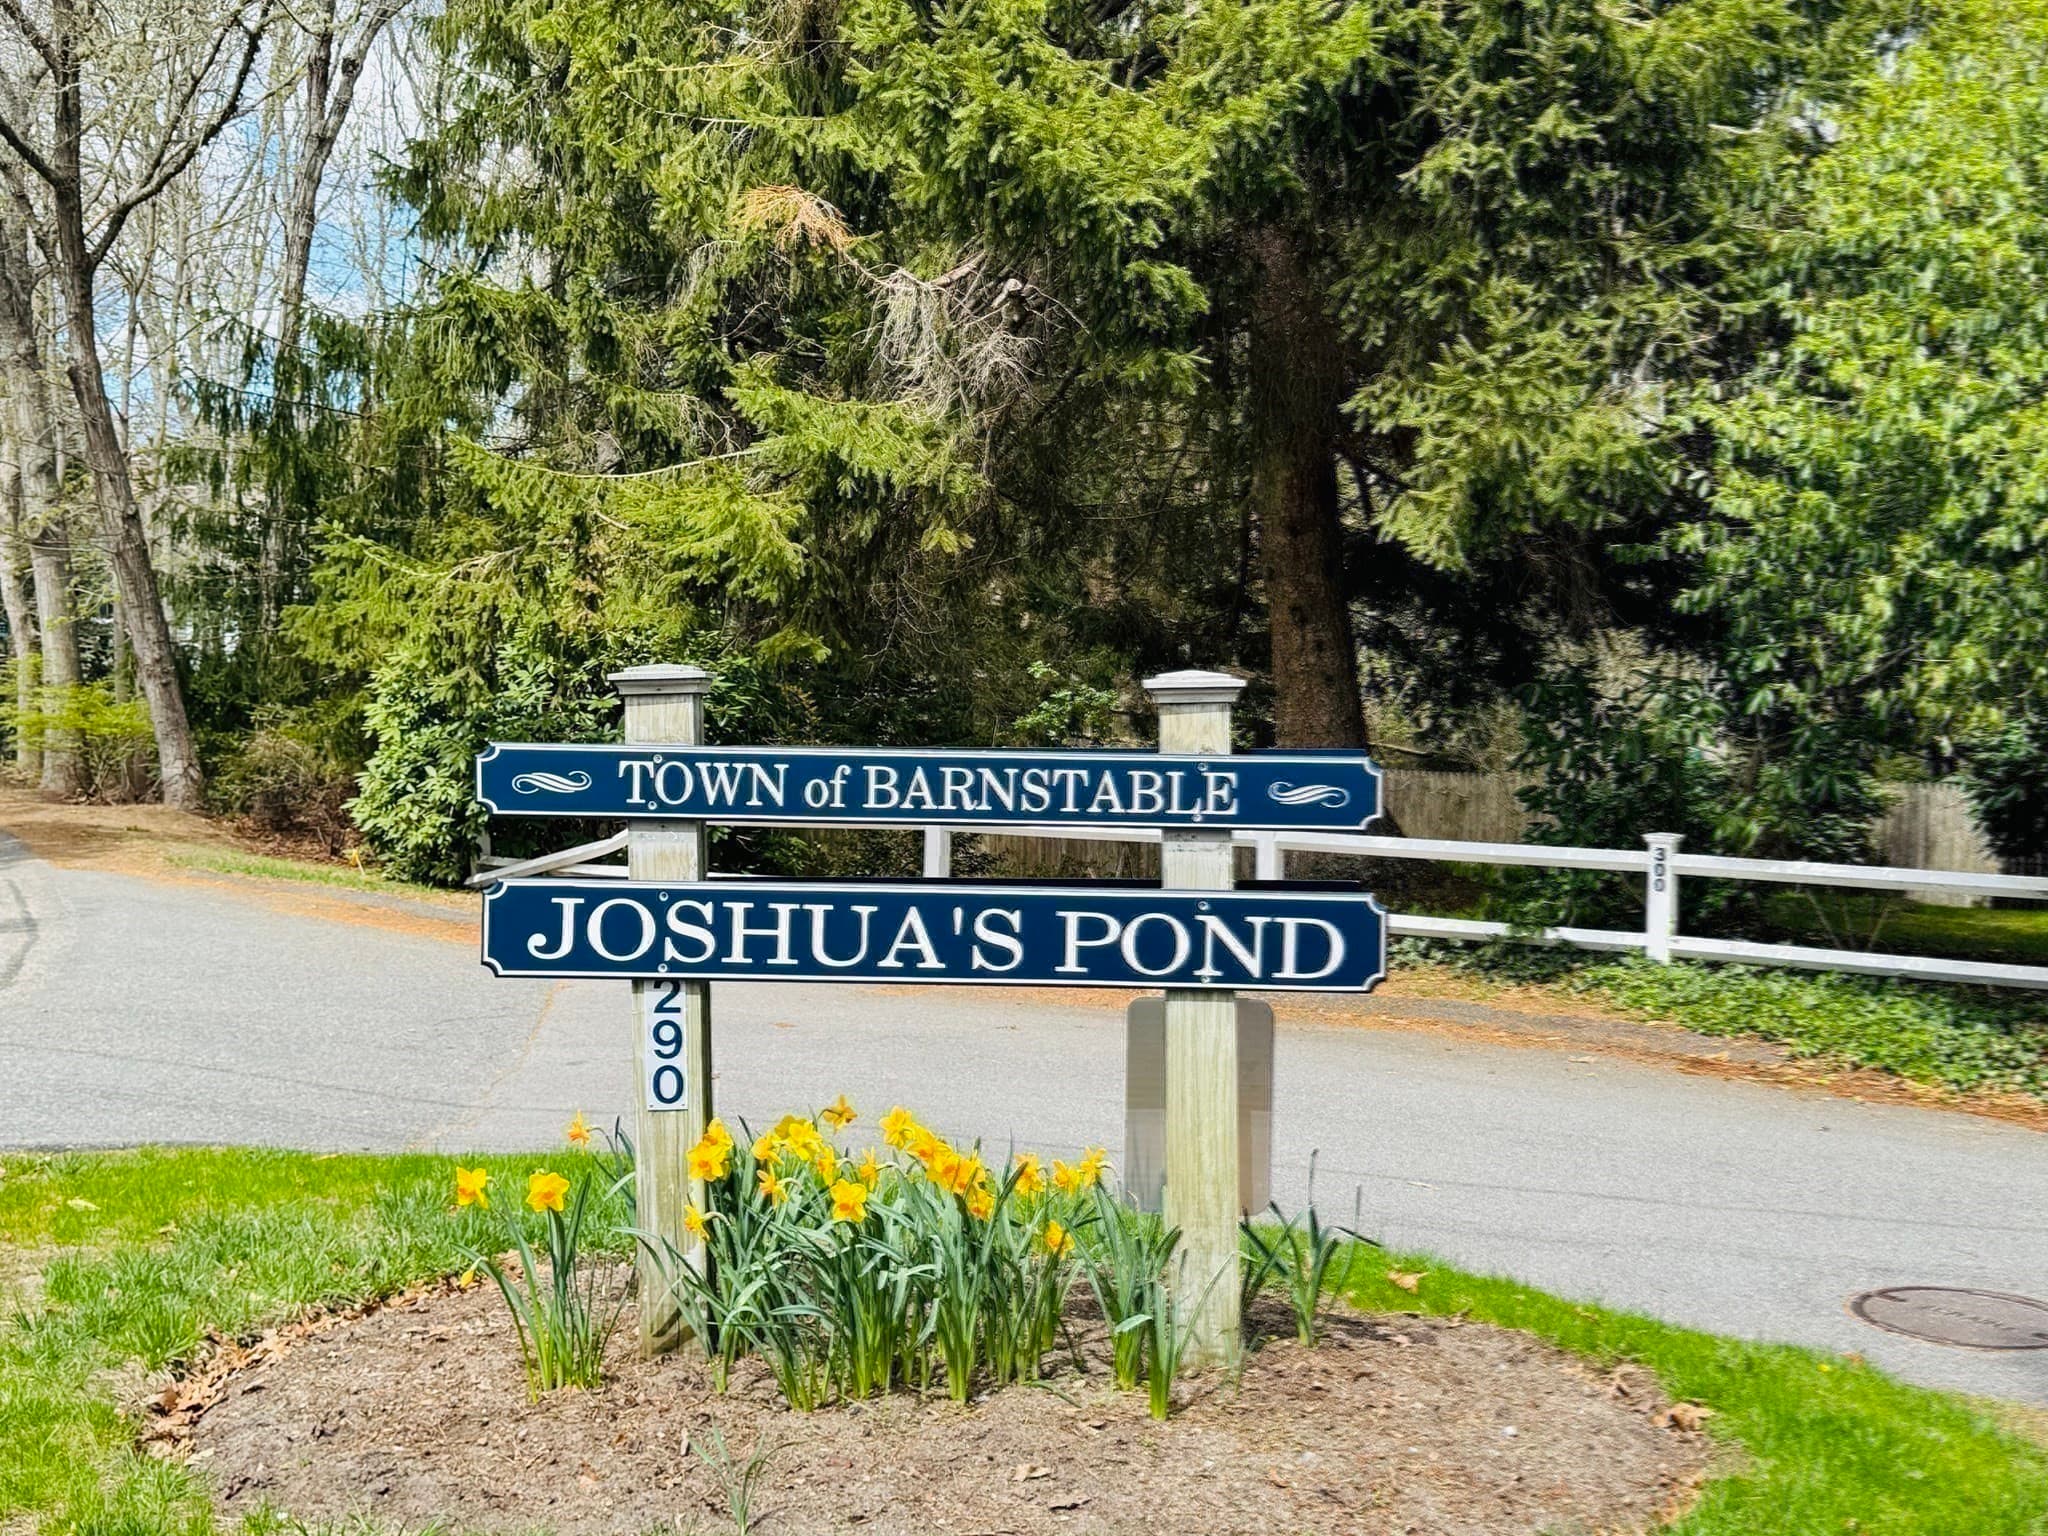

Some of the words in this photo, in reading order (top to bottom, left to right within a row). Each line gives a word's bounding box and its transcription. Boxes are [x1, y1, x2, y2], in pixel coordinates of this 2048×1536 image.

[618, 760, 789, 807] TOWN
[804, 765, 851, 809] of
[862, 766, 1238, 815] BARNSTABLE
[1653, 847, 1666, 892] 300
[527, 897, 1024, 972] JOSHUA'S
[1055, 910, 1346, 980] POND
[652, 979, 684, 1104] 290
